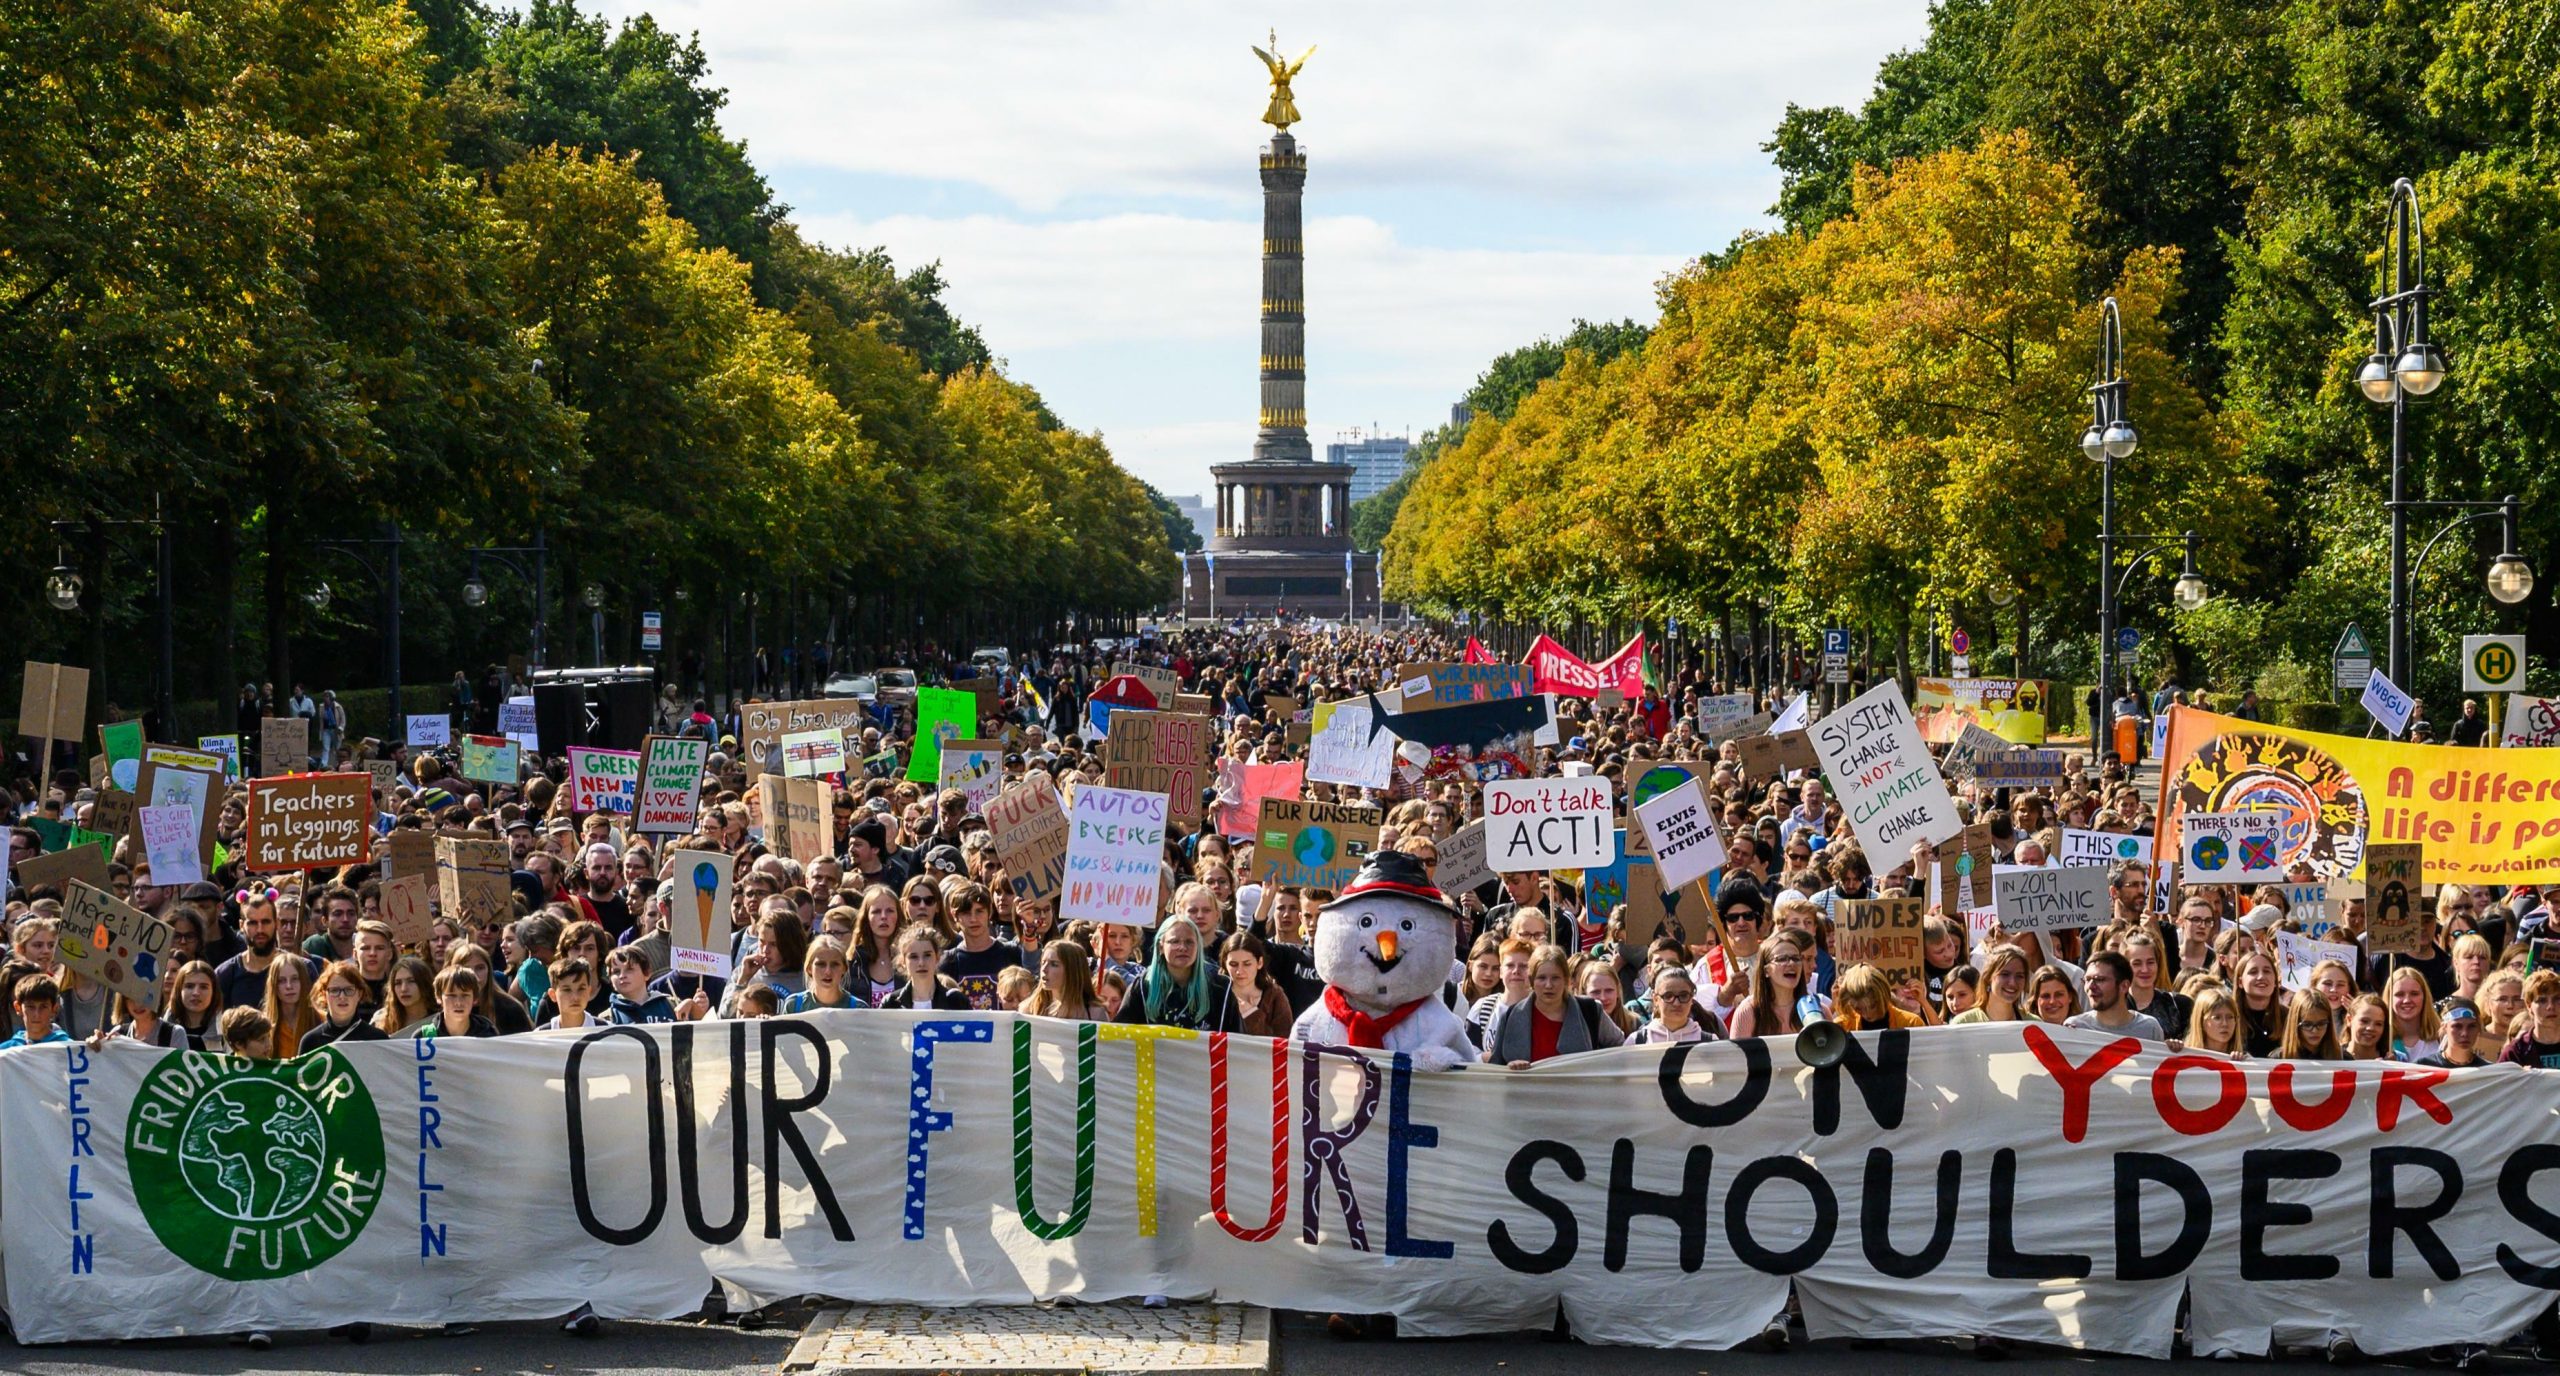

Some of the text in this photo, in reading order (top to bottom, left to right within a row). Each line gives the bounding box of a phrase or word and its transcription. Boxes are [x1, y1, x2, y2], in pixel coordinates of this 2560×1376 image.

[1828, 632, 1842, 651] P
[1156, 670, 1174, 682] DIE
[1540, 651, 1620, 690] PRESSE!
[2486, 652, 2506, 675] H
[1950, 680, 2018, 691] KLIMAKOMA?
[1953, 689, 2013, 699] OHNE S&G!
[2370, 678, 2407, 716] WBGU
[1821, 697, 1903, 758] SYSTEM
[200, 738, 224, 748] Klima
[652, 741, 699, 761] HATE
[1111, 719, 1200, 767] MEHR LIEBE
[1839, 732, 1901, 777] CHANGE
[369, 762, 393, 776] ECO
[648, 764, 700, 778] CLIMATE
[1860, 760, 1894, 789] NOT
[2386, 766, 2414, 799] A
[580, 776, 620, 793] NEW
[653, 777, 692, 790] CHANGE
[1853, 767, 1932, 824] CLIMATE
[256, 783, 355, 815] Teachers
[581, 794, 596, 810] 4
[988, 780, 1055, 835] FUCK
[1078, 789, 1166, 822] AUTOS
[1490, 786, 1612, 816] Don't talk.
[142, 810, 162, 825] ES
[260, 811, 360, 842] in leggings
[644, 811, 693, 824] DANCING!
[1308, 805, 1381, 827] UNSERE
[1656, 804, 1697, 832] ELVIS
[1878, 806, 1933, 844] CHANGE
[2187, 816, 2262, 831] THERE IS NO
[2382, 807, 2455, 843] life
[2469, 811, 2502, 845] is
[994, 826, 1031, 852] EACH
[1507, 815, 1601, 857] ACT!
[1657, 825, 1714, 861] FUTURE
[1666, 820, 1698, 842] FOR
[260, 841, 358, 863] for future
[1002, 827, 1065, 874] not THE
[2067, 834, 2113, 856] THIS
[1070, 855, 1099, 872] BUS
[1100, 855, 1114, 875] &
[2002, 872, 2058, 894] IN 2019
[2009, 889, 2095, 915] TITANIC
[59, 918, 94, 939] planet
[70, 883, 168, 954] There is NO
[1892, 903, 1921, 929] ES
[2000, 914, 2039, 930] would
[676, 949, 720, 964] WARNING:
[1839, 932, 1919, 961] WANDELT
[1658, 1024, 2454, 1143] ON YOUR
[415, 1037, 447, 1262] BERLIN
[565, 1018, 1455, 1260] OUR FUTURE
[67, 1044, 94, 1275] BERLIN
[223, 1157, 381, 1270] FUTURE
[1486, 1137, 2560, 1291] SHOULDERS
